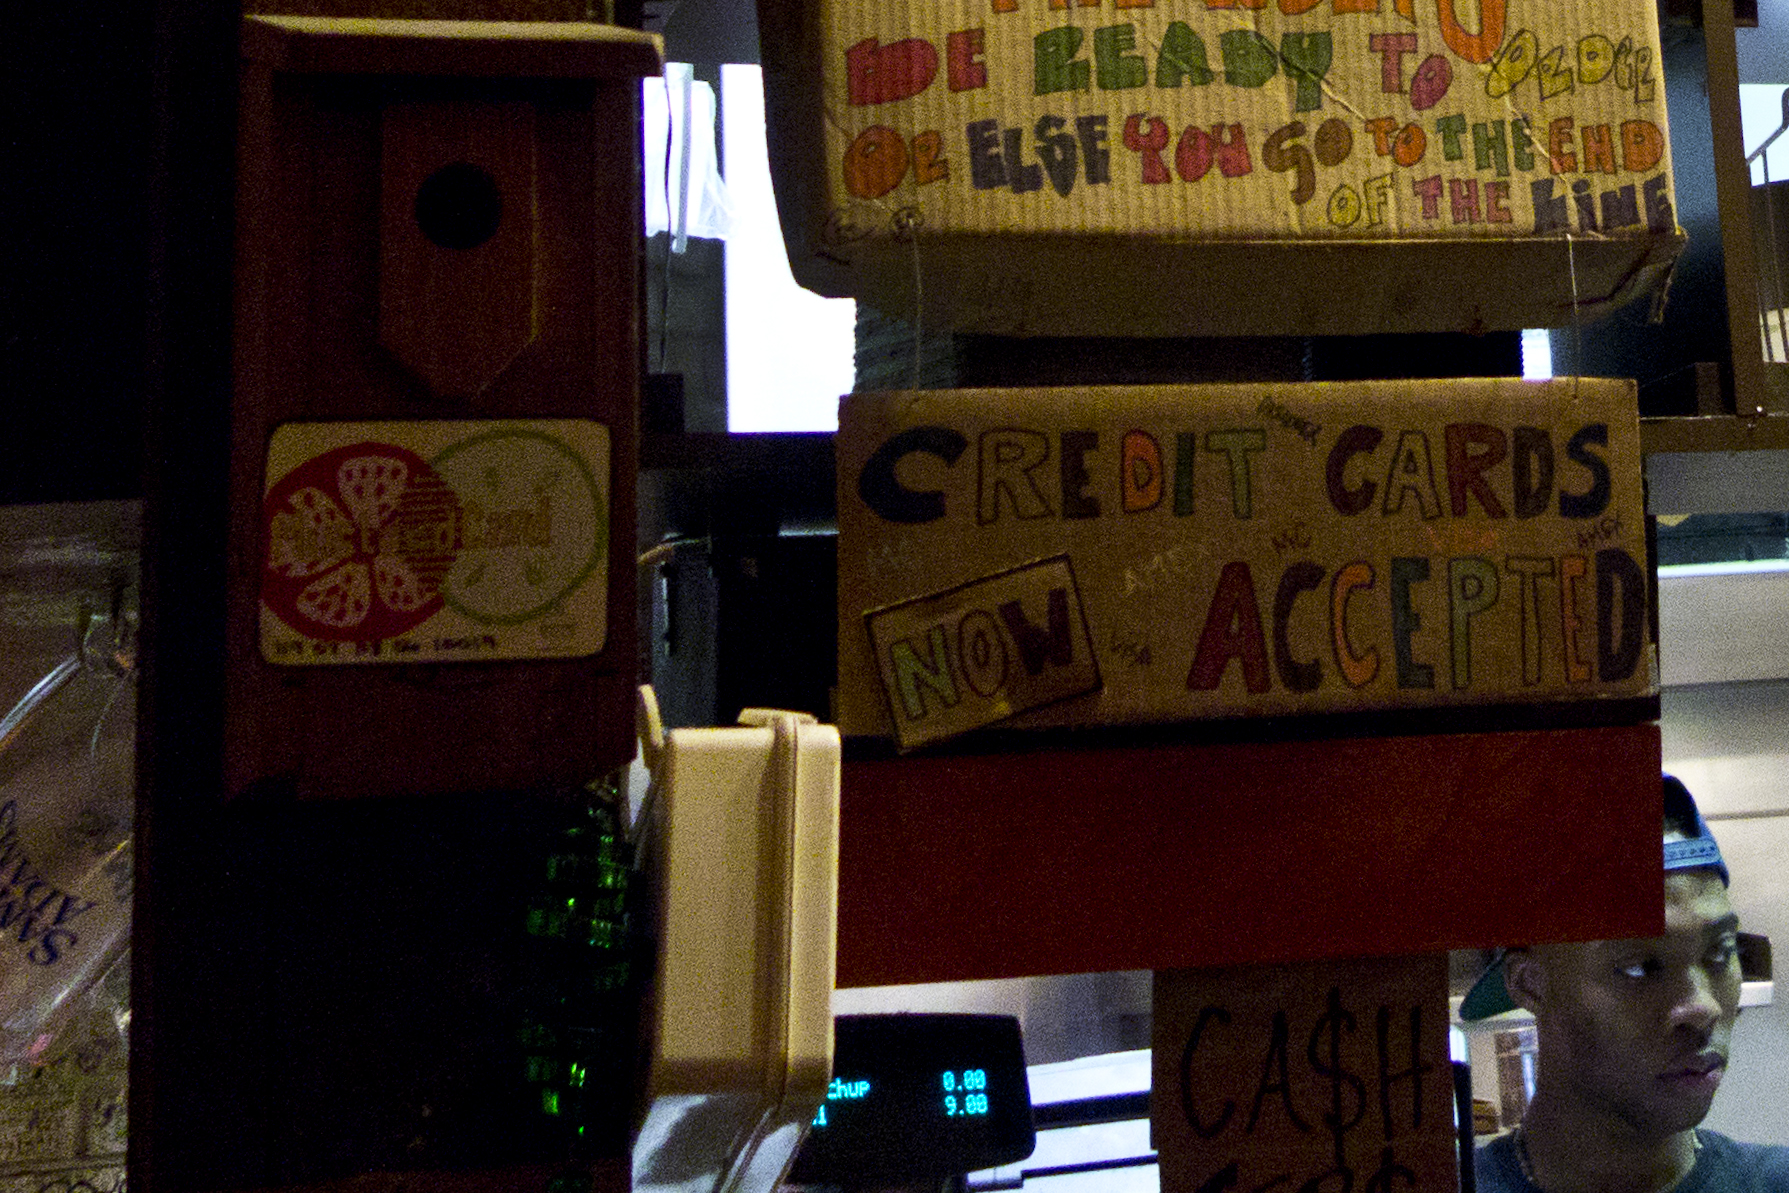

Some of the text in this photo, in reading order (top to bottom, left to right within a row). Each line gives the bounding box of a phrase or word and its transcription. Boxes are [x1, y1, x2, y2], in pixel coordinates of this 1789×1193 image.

[843, 25, 990, 107] BE
[1032, 19, 1335, 115] READY
[1368, 31, 1455, 111] TO
[840, 111, 1666, 207] OR ELSE YOU GO TO THE END
[1325, 173, 1396, 230] OF
[1412, 175, 1515, 226] THE
[856, 423, 1268, 527] CREDIT
[1324, 421, 1614, 519] CARDS
[886, 546, 1647, 723] NOW ACCEPTED
[826, 1068, 987, 1101] chup 0.00
[943, 1092, 989, 1117] 9.00
[1181, 987, 1432, 1169] CA$H
